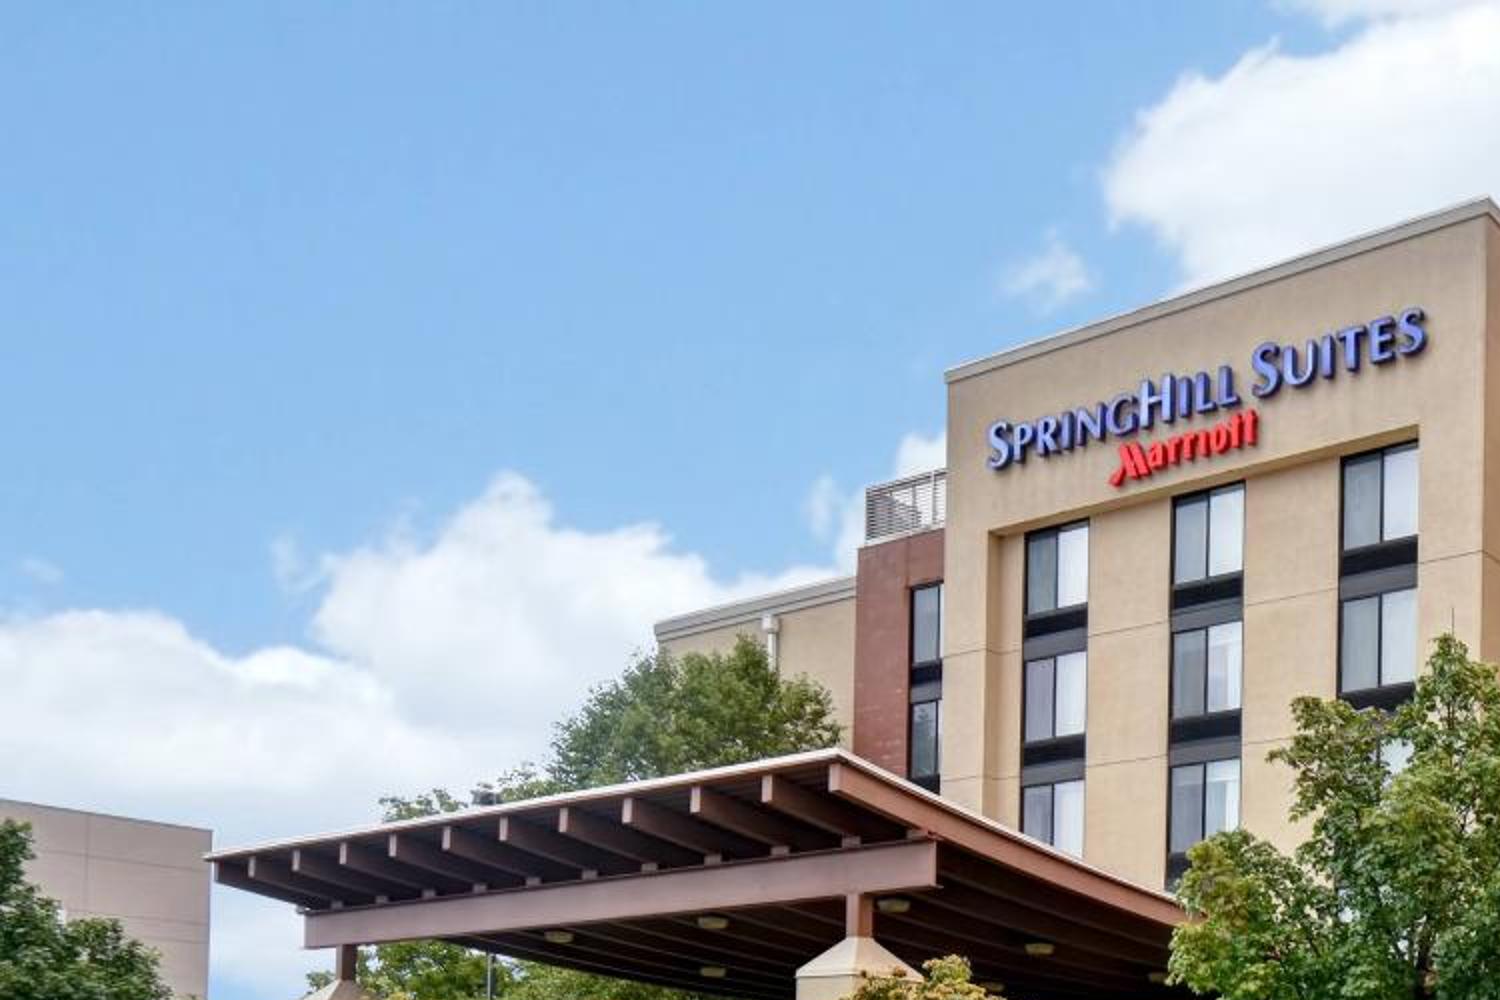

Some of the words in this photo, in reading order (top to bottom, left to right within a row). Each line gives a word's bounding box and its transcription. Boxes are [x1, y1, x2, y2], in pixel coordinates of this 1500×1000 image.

[987, 365, 1241, 471] SPRINGHILL
[1252, 307, 1427, 399] SUITES
[1109, 409, 1260, 487] Marriott
